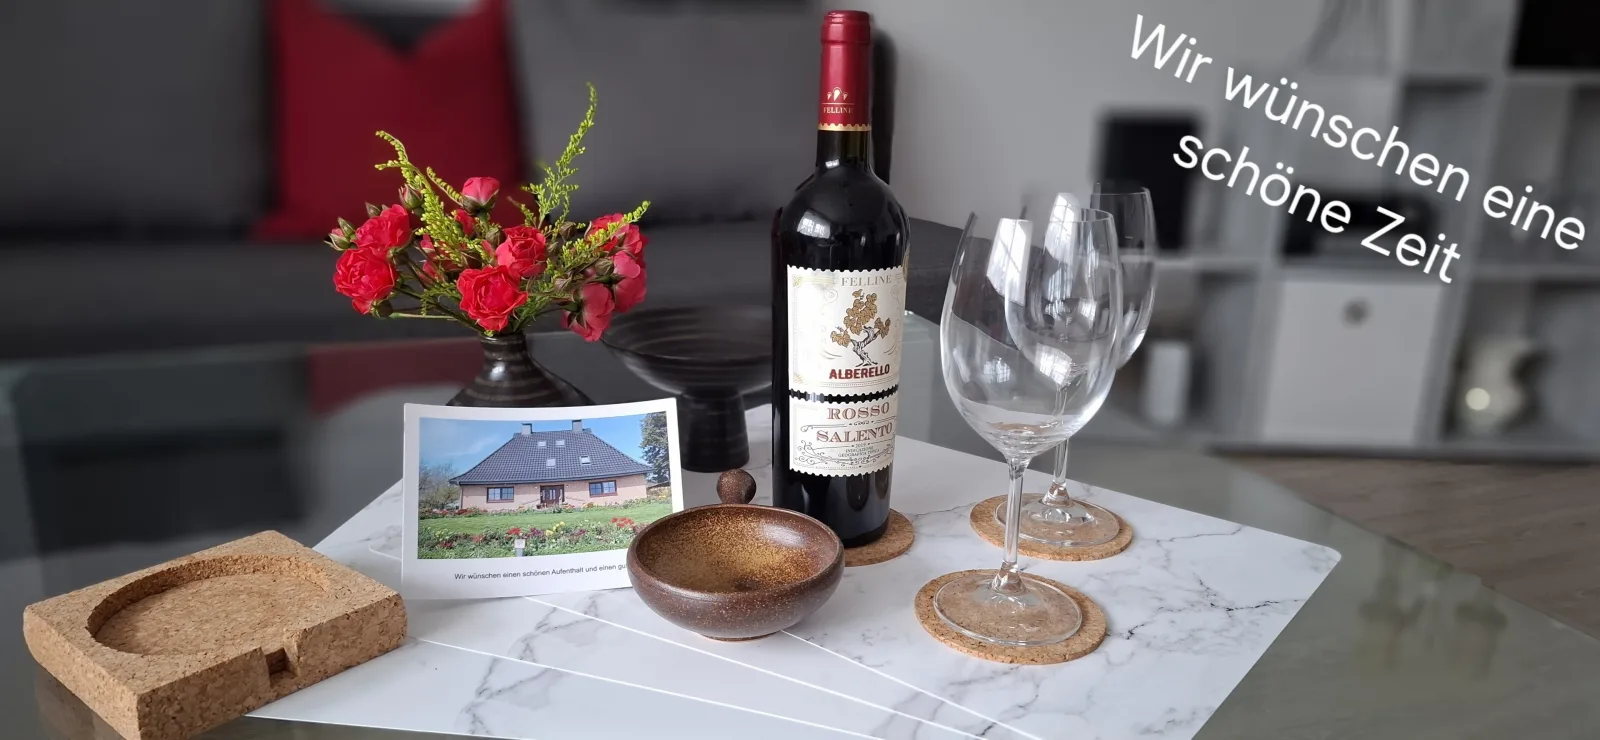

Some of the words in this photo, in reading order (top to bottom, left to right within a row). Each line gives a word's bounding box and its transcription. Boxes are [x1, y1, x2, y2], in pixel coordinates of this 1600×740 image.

[841, 275, 892, 287] FELLINE
[829, 363, 890, 380] ALBERELLO
[827, 401, 890, 420] ROSSO
[816, 422, 893, 443] SALENTO
[468, 572, 501, 580] wünschen
[522, 569, 550, 577] schönen
[551, 567, 584, 576] Aufenthalt
